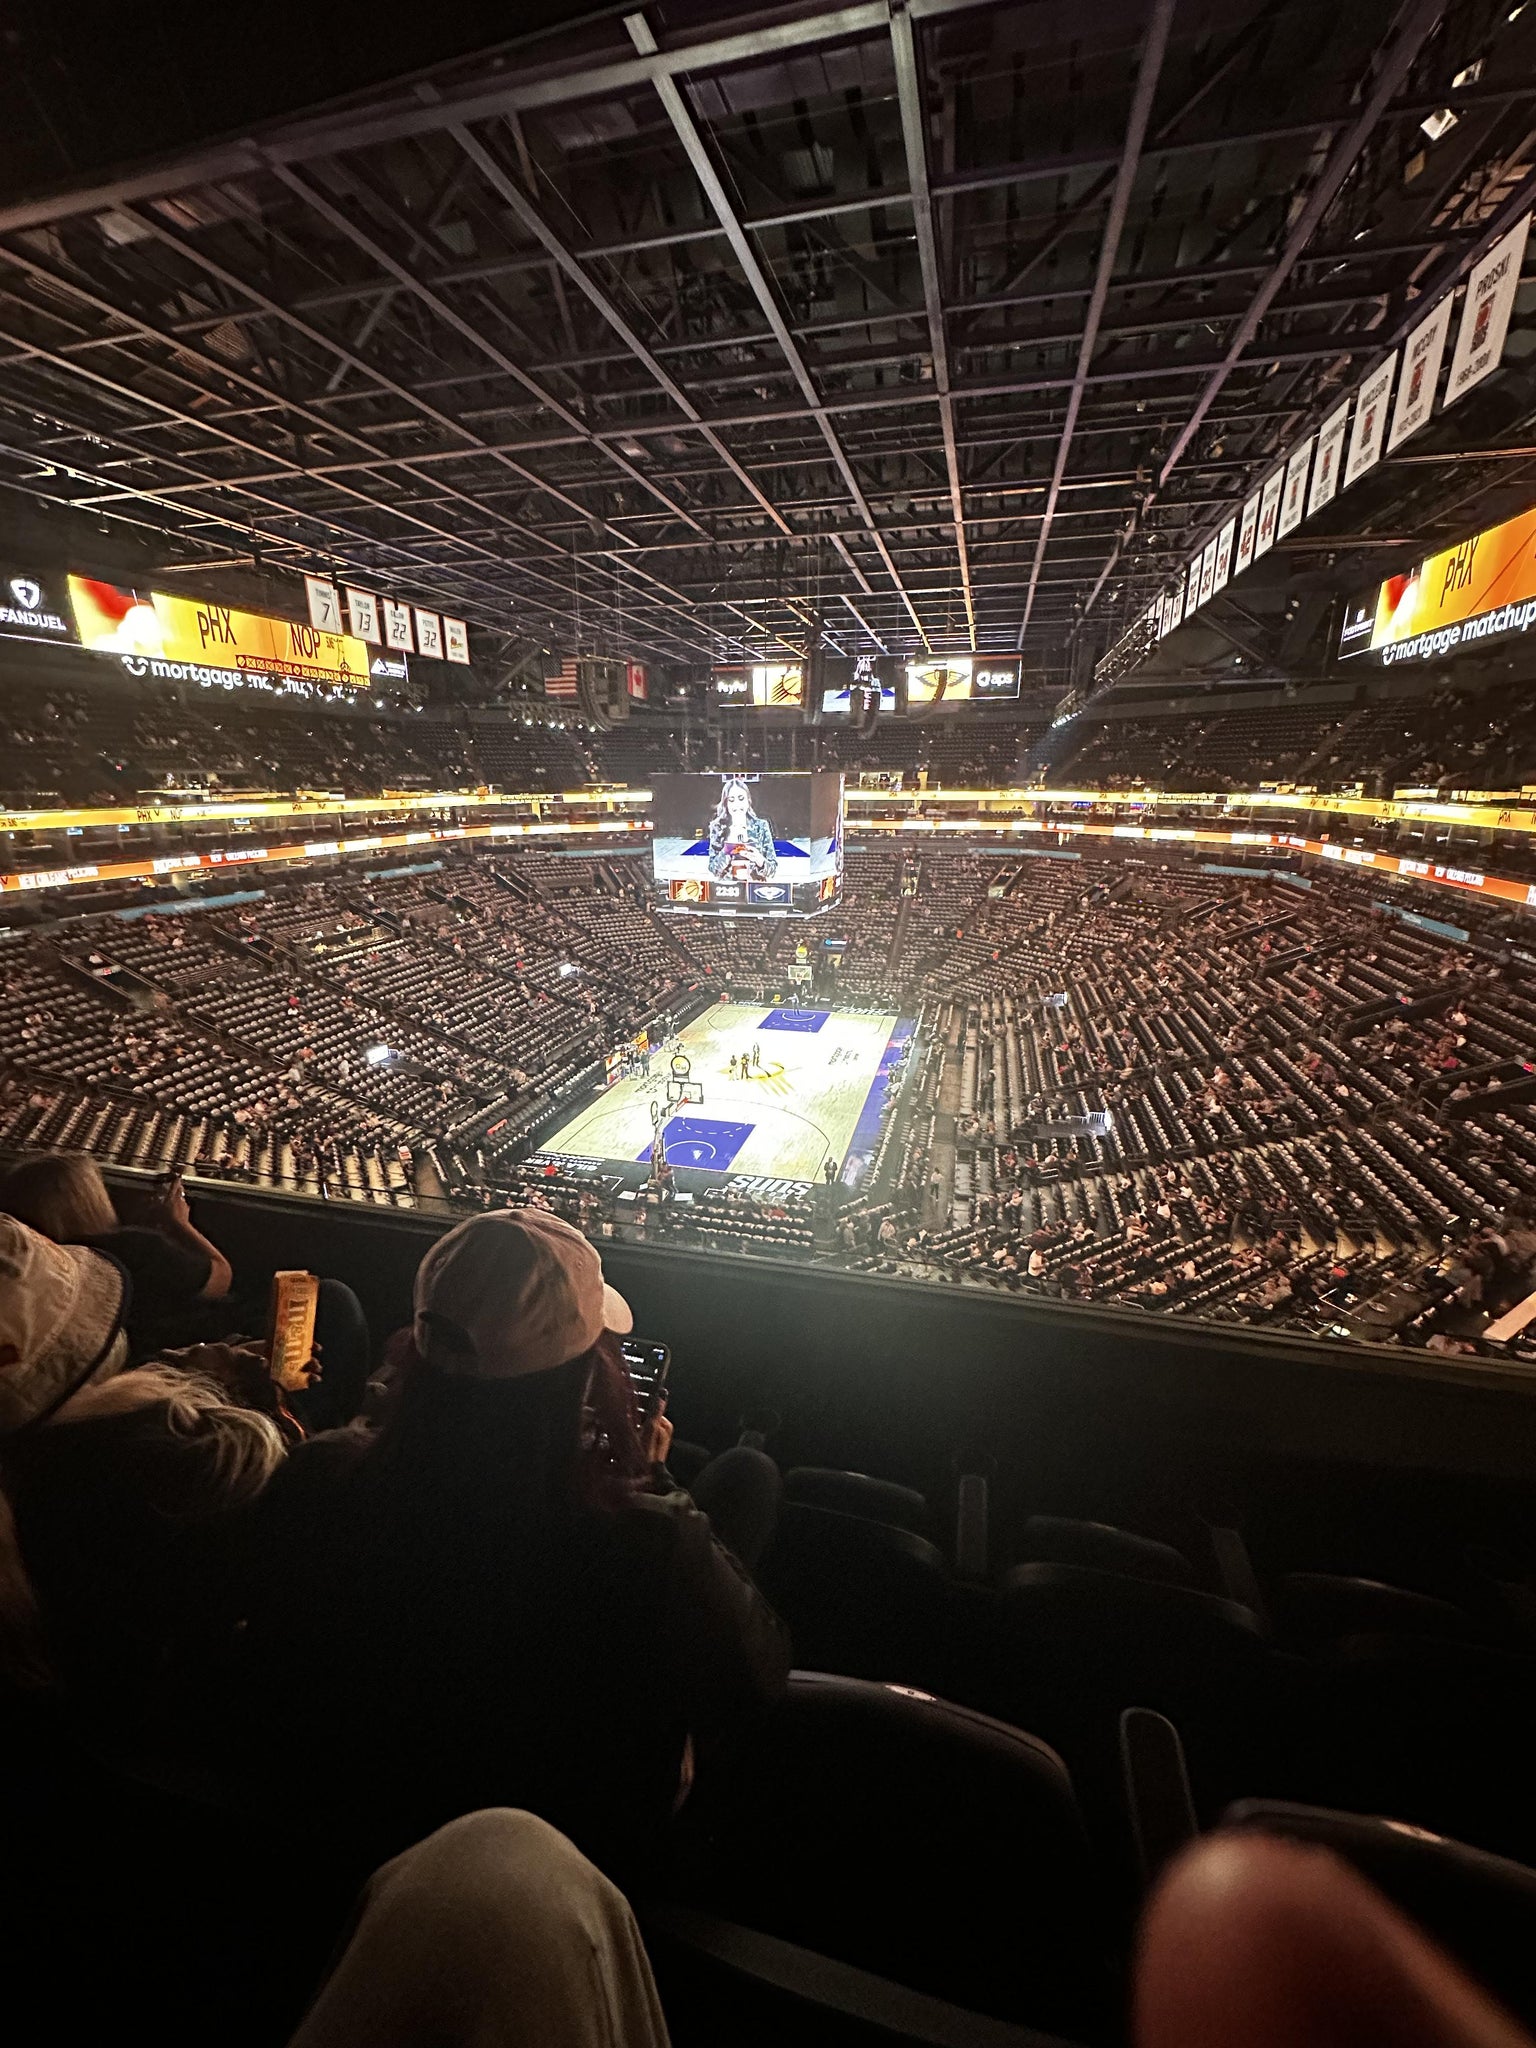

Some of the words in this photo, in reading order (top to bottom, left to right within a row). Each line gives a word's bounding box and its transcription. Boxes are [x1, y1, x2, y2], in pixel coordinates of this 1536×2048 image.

[1440, 536, 1480, 607] PHX
[0, 607, 67, 631] FANDUEL
[320, 602, 330, 623] 7
[359, 611, 371, 632] 13
[196, 604, 238, 649] PHX
[392, 621, 407, 640] 22
[1395, 626, 1461, 658] mortgage
[1461, 600, 1536, 642] matchup
[423, 630, 437, 648] 32
[150, 660, 244, 690] mortgage
